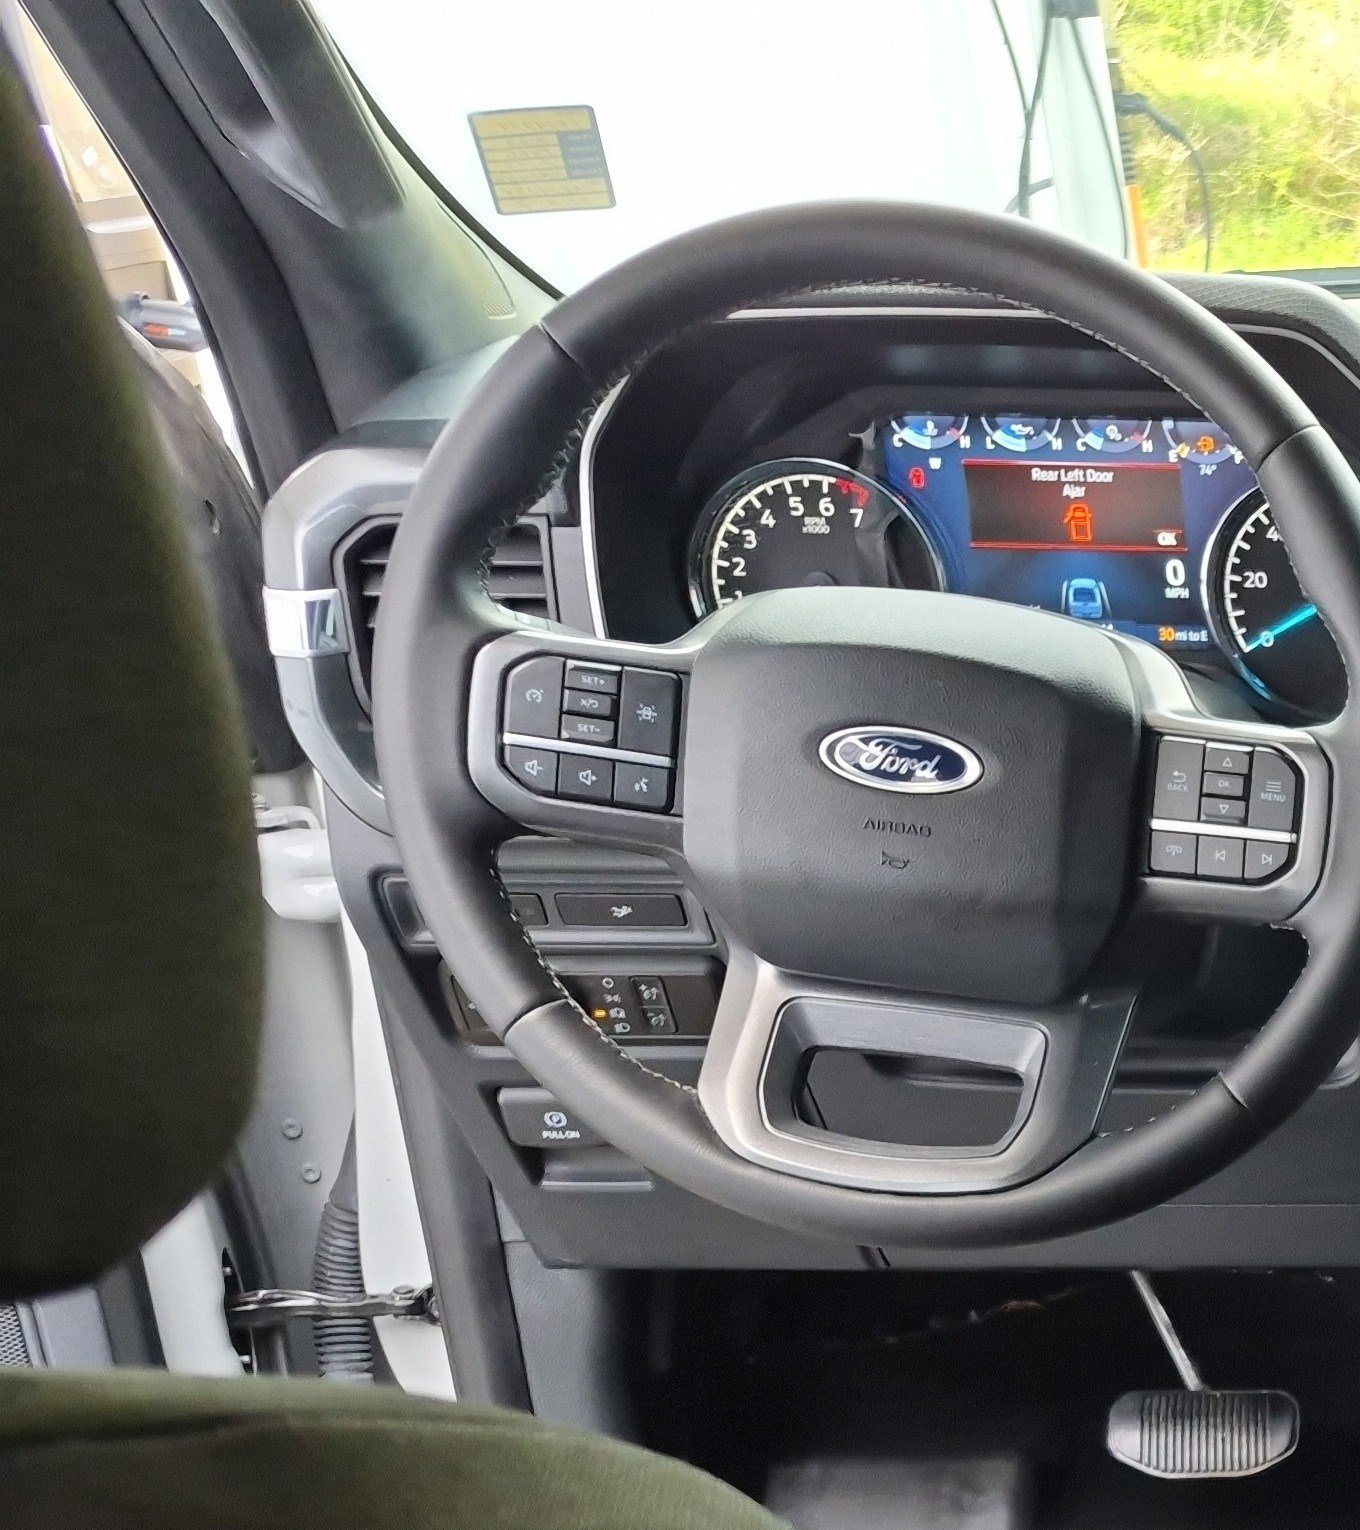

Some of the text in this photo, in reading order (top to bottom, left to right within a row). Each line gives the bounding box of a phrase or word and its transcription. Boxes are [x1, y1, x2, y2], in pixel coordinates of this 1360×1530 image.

[1031, 468, 1114, 483] Rear Left Door
[1063, 484, 1086, 498] Ajar
[788, 497, 804, 516] 5
[819, 498, 835, 516] 6
[760, 509, 776, 529] 4
[850, 508, 864, 528] 7
[742, 529, 757, 549] 3
[1266, 526, 1285, 542] 4
[732, 558, 747, 577] 2
[1164, 559, 1185, 586] 0
[1243, 572, 1268, 588] 20
[1164, 587, 1189, 599] MPH
[1158, 627, 1175, 642] 30
[1261, 631, 1274, 647] 0
[859, 738, 942, 779] Ford
[1166, 782, 1189, 793] BACK
[1217, 779, 1230, 788] OK
[1260, 792, 1286, 803] MENU
